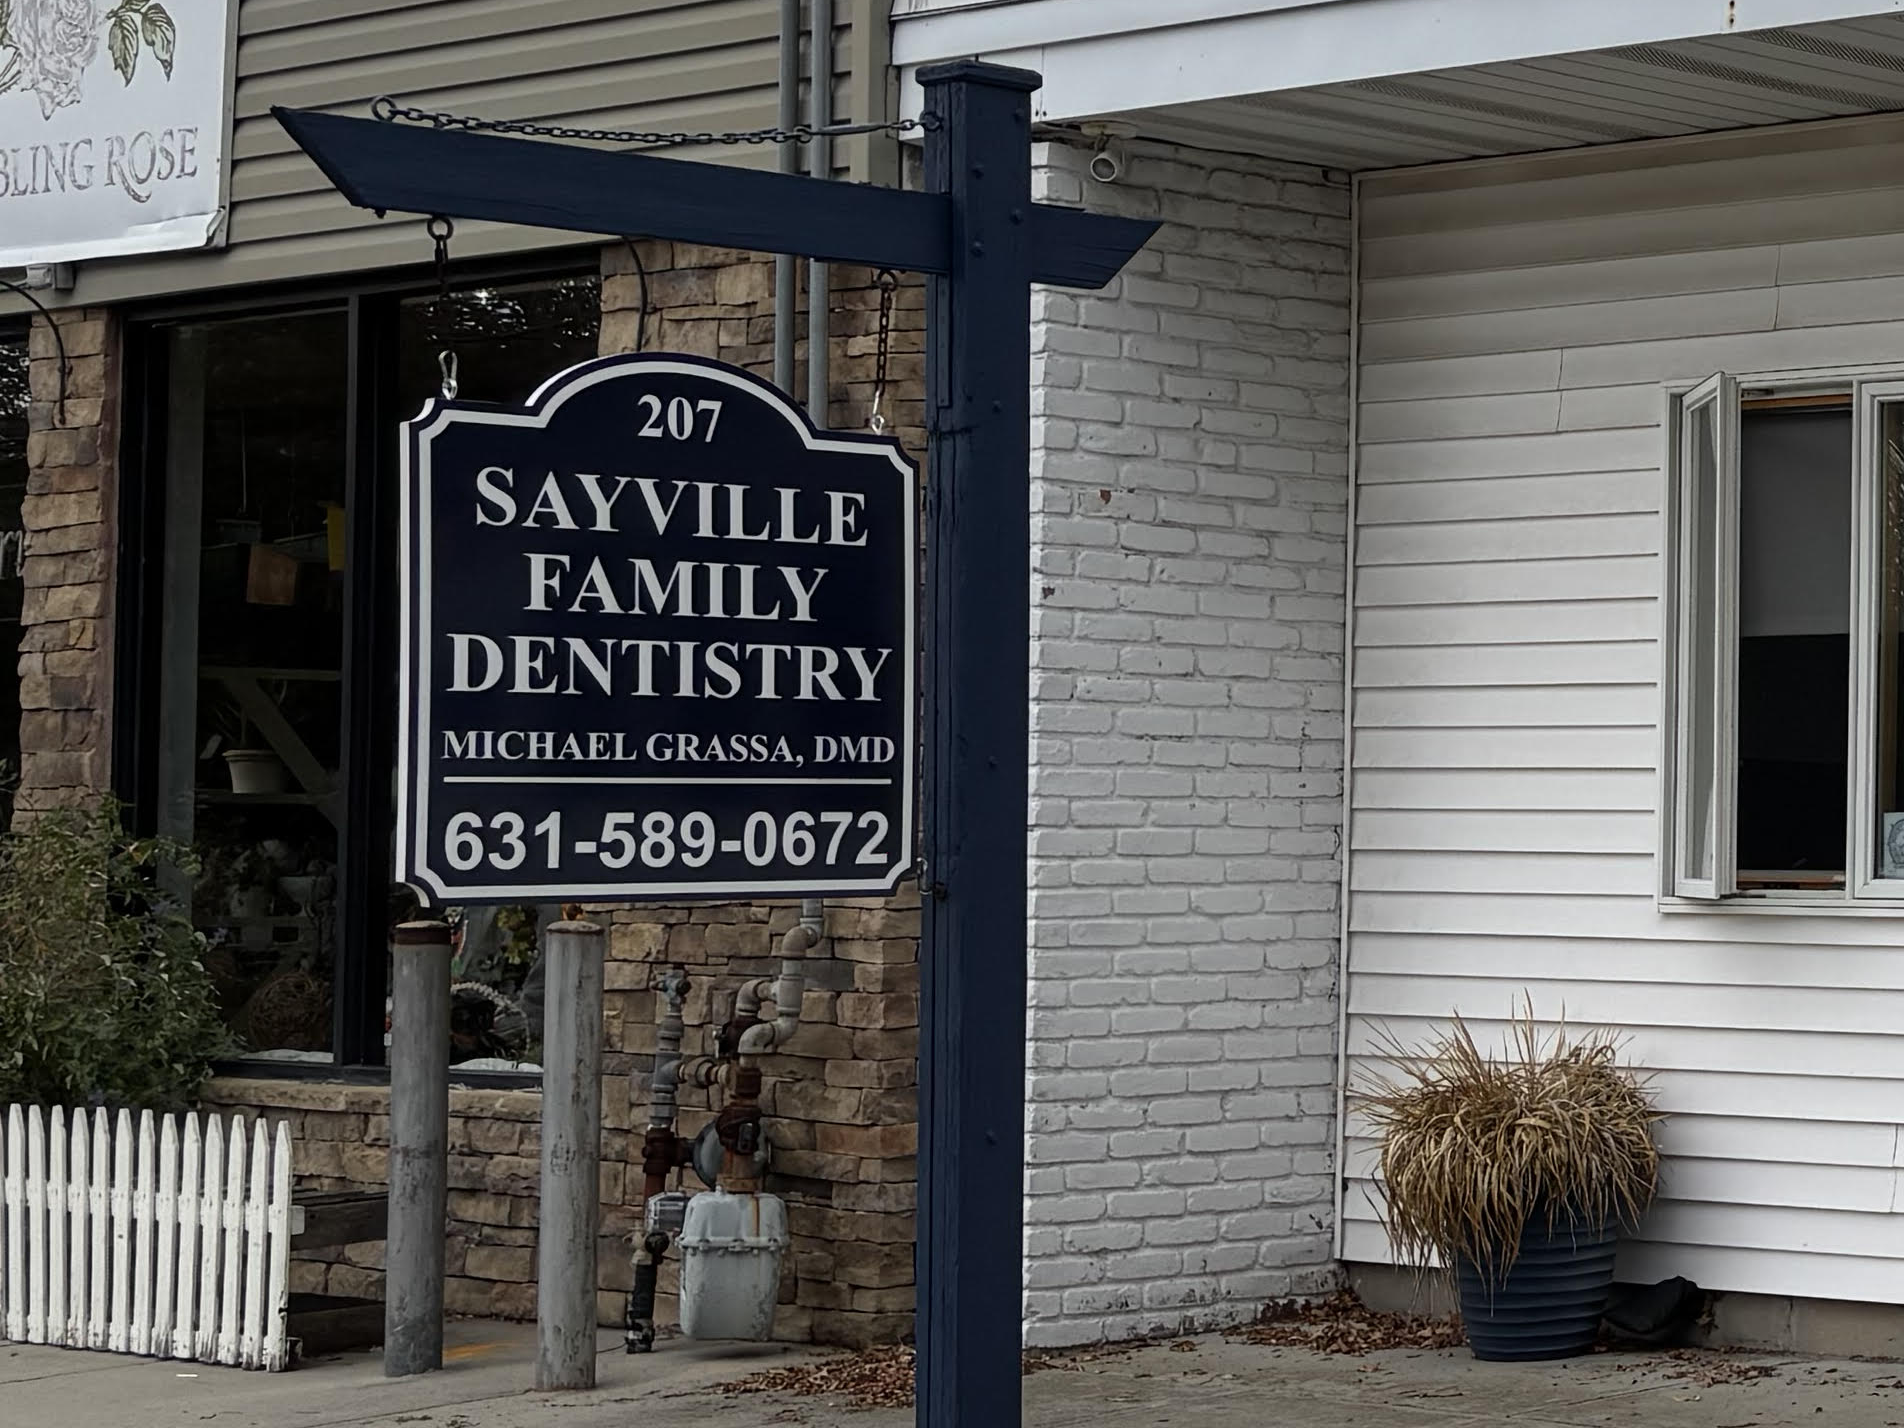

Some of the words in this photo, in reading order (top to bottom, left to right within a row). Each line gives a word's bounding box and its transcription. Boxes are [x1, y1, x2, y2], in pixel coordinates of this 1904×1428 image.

[104, 127, 198, 203] ROSE
[637, 394, 723, 443] 207
[476, 466, 868, 547] SAYVILLE
[523, 552, 829, 622] FAMILY
[445, 633, 893, 702] DENTISTRY
[441, 730, 638, 762] MICHAEL
[645, 732, 804, 768] GRASSA,
[813, 735, 895, 763] DMD
[444, 810, 888, 871] 631-589-0672
